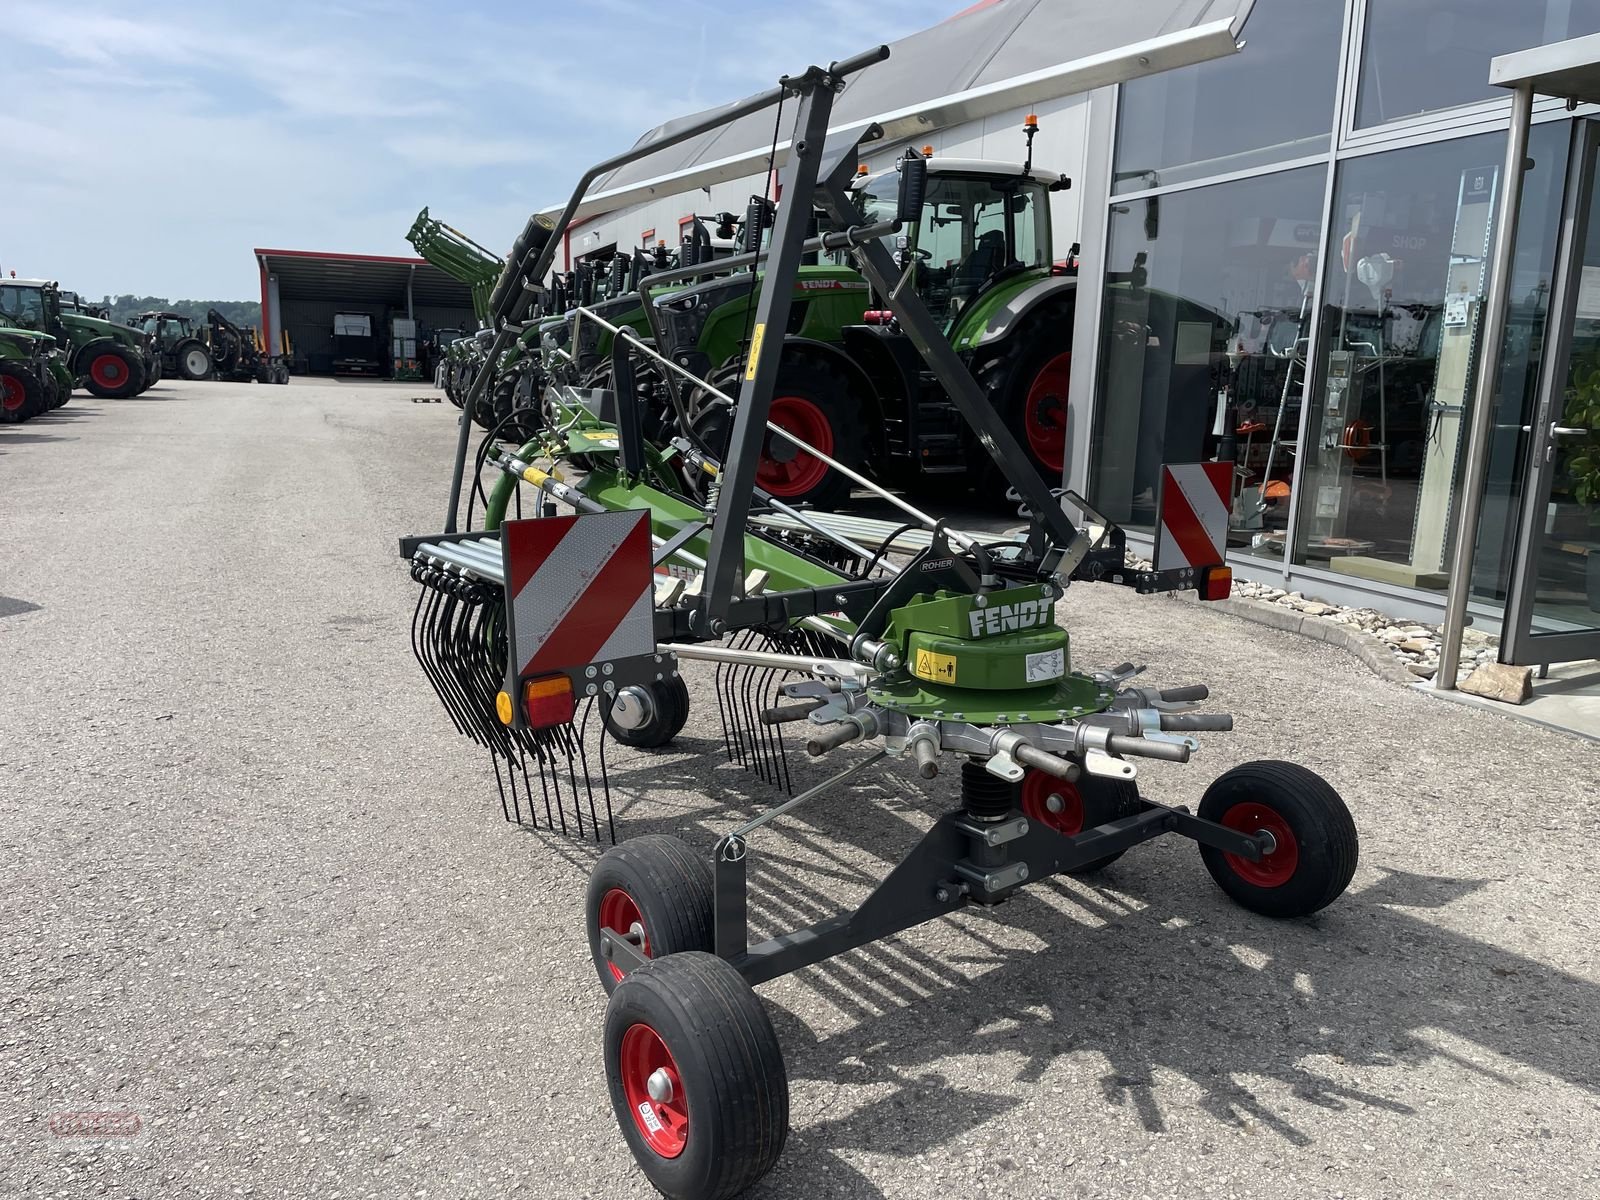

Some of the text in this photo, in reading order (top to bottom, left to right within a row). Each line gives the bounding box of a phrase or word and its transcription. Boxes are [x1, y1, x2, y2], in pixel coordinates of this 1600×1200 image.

[1392, 235, 1427, 250] SHOP
[801, 279, 837, 289] FENDT
[668, 563, 704, 582] FEN
[921, 559, 953, 571] ROHER
[967, 597, 1054, 637] FENDT
